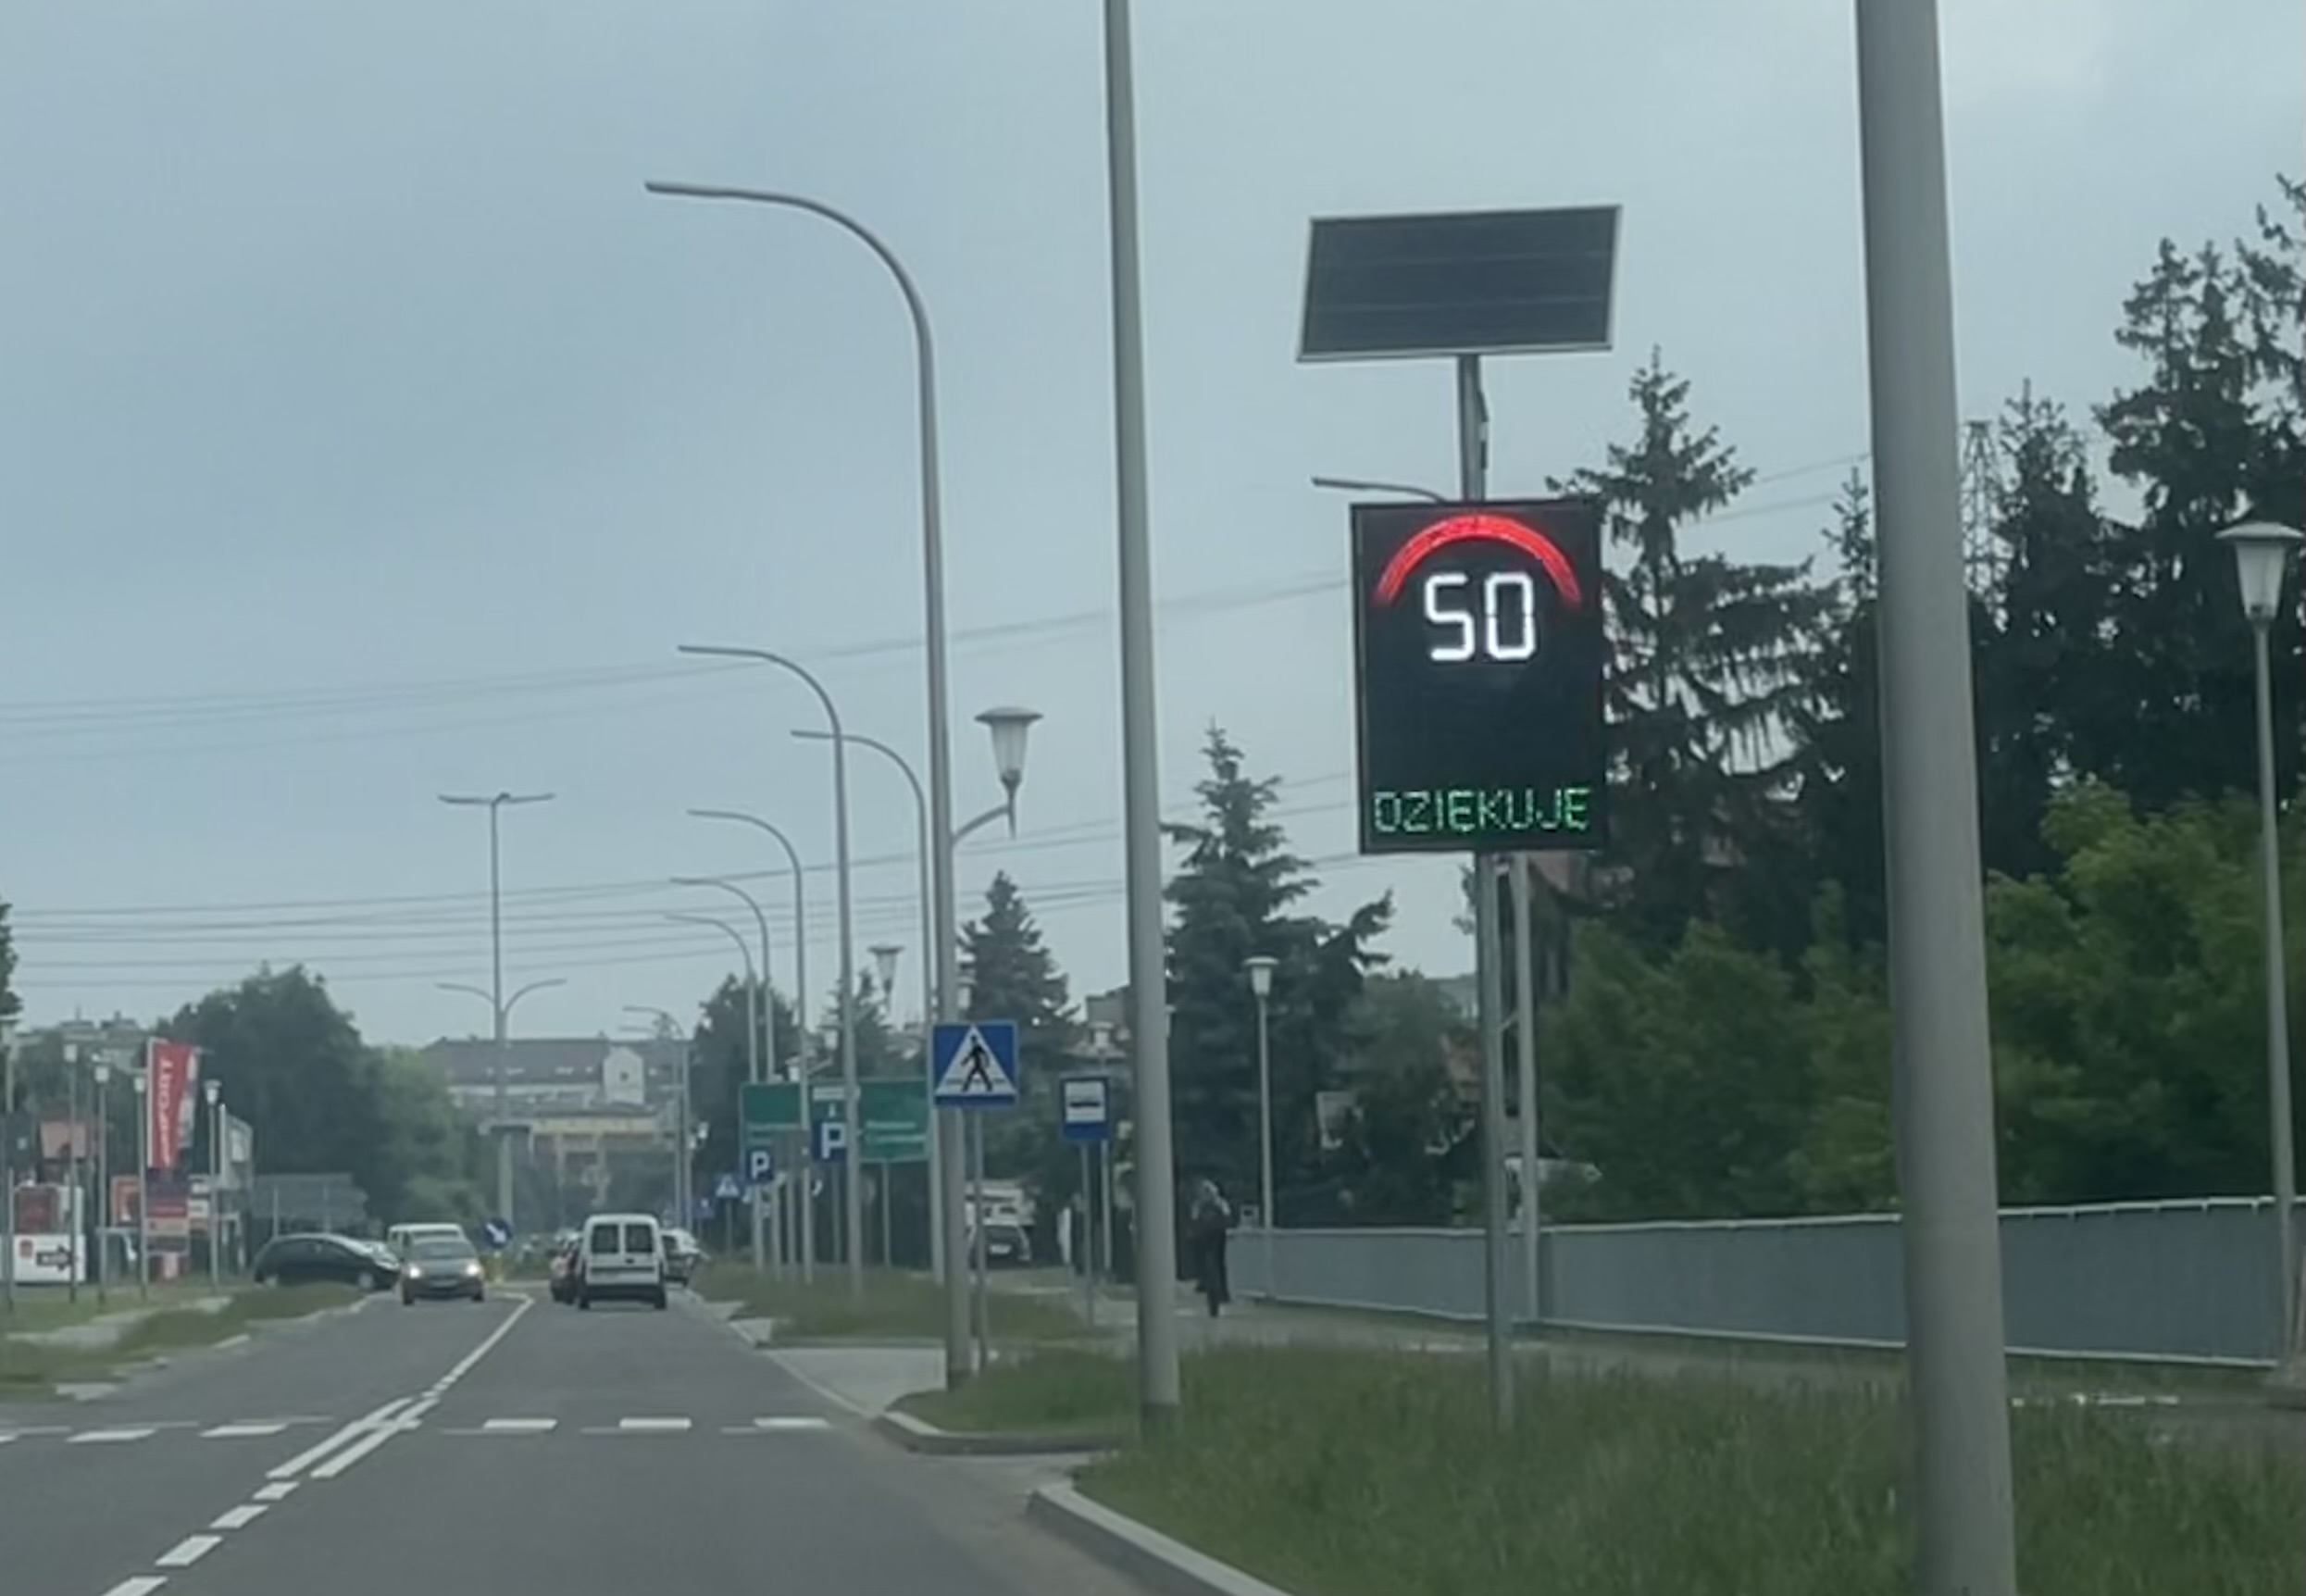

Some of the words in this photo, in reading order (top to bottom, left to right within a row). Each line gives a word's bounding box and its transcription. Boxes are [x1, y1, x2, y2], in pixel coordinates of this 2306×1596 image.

[1425, 571, 1536, 661] 50
[820, 1122, 846, 1159] P
[750, 1151, 770, 1179] P
